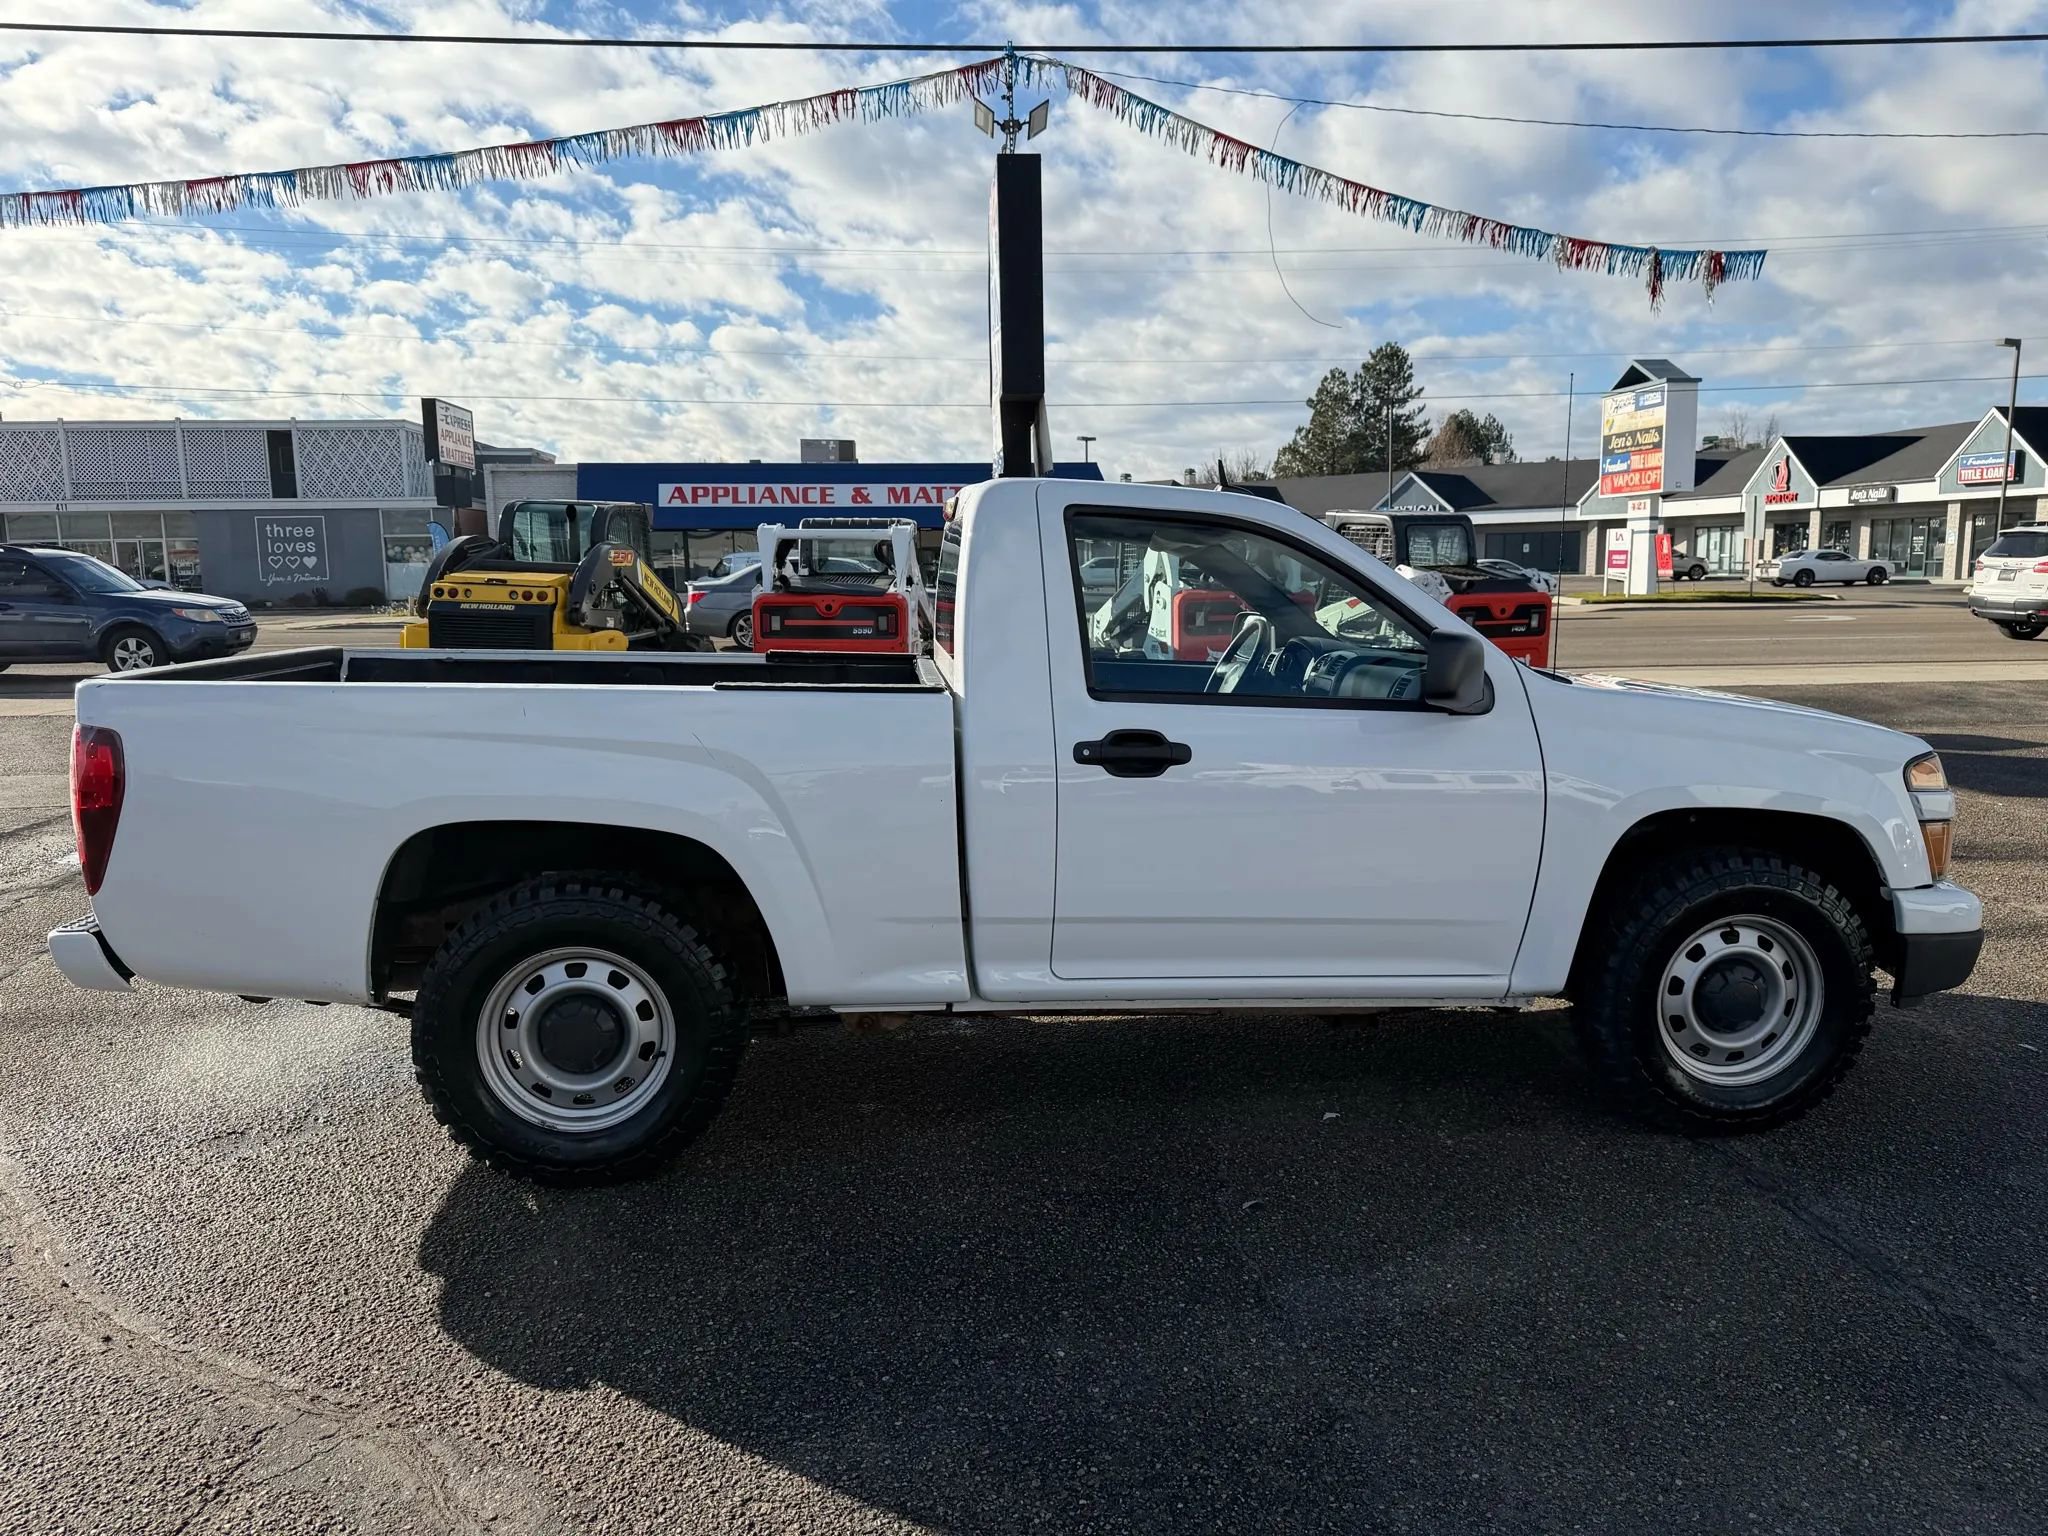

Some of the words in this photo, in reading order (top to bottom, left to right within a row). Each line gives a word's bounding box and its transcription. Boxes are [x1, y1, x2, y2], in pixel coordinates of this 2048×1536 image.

[440, 428, 471, 449] APPLIANCE
[1608, 432, 1633, 450] Jen's
[1634, 429, 1661, 446] Nails
[440, 446, 446, 459] &
[446, 447, 474, 465] MATTRESS
[1612, 471, 1641, 488] VAPOR
[1642, 469, 1661, 486] LOFT
[1960, 469, 1982, 481] TITLE
[667, 486, 835, 505] APPLIANCE
[850, 486, 873, 505] &
[1851, 489, 1867, 501] Jen's
[1868, 487, 1888, 499] Nails
[265, 523, 315, 538] three
[267, 538, 317, 554] loves
[460, 602, 480, 610] NEW
[480, 602, 516, 611] HOLLAND
